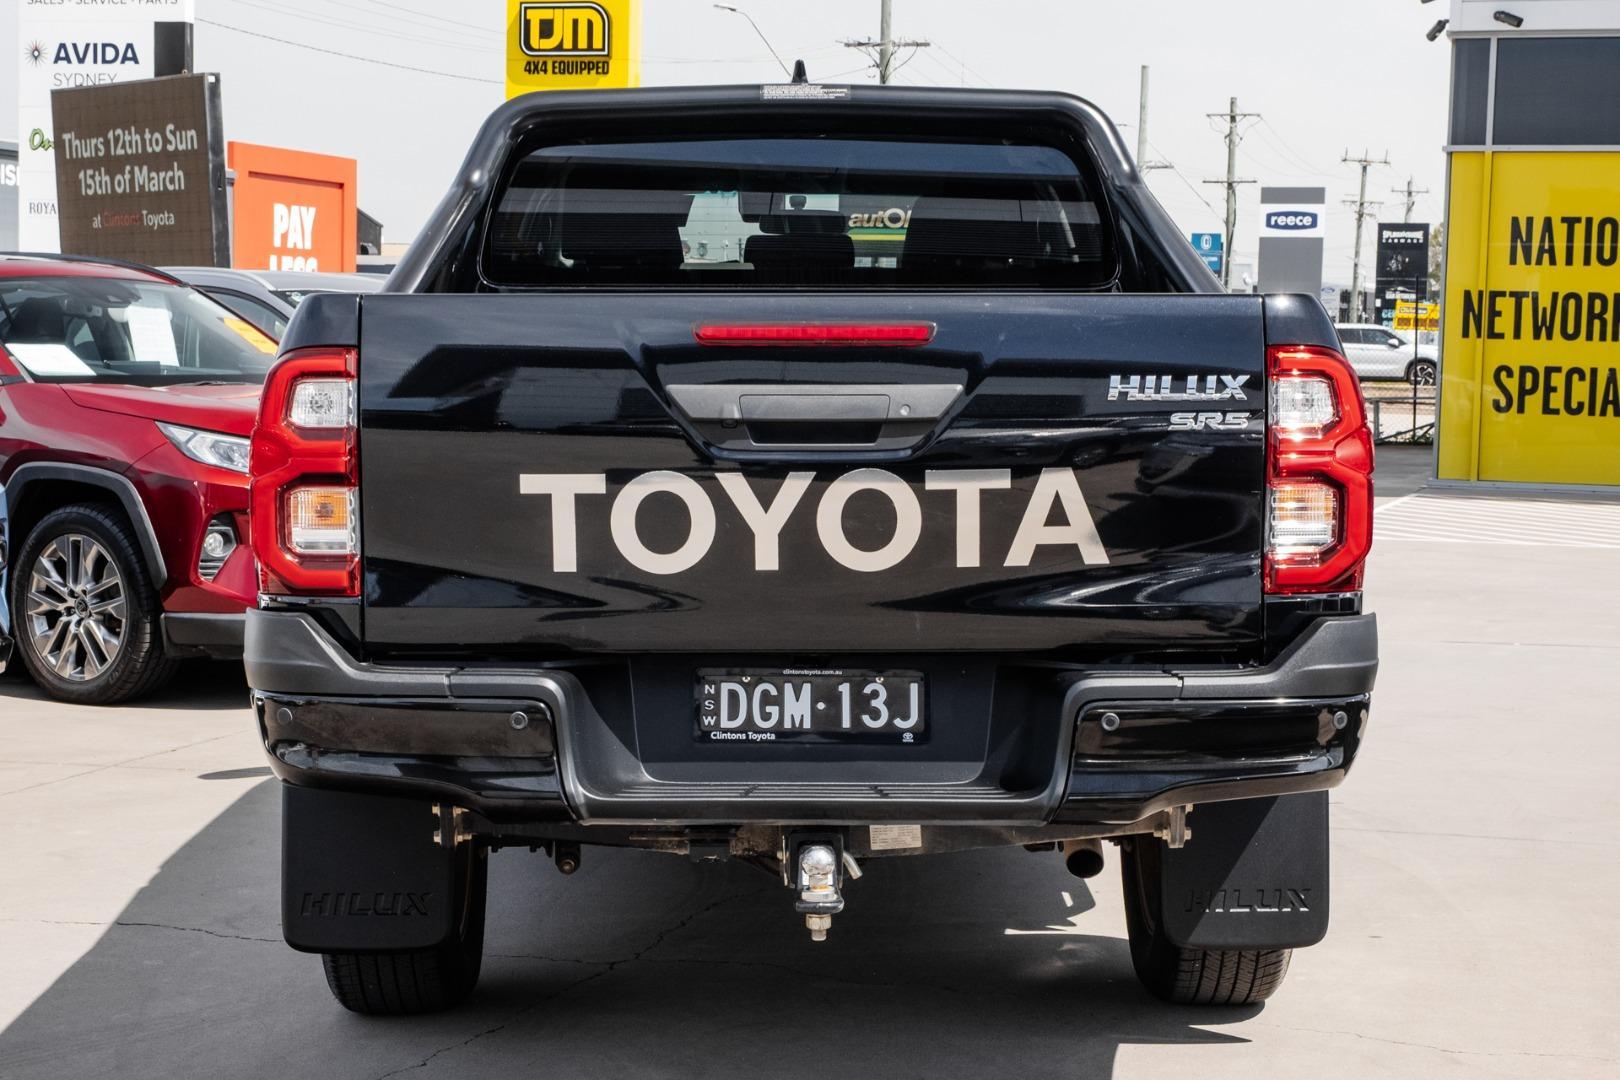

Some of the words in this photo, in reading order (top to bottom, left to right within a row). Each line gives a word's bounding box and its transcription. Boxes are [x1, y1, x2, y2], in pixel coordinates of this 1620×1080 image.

[526, 8, 603, 50] TJM
[53, 42, 140, 65] AVIDA
[53, 72, 117, 87] SYDNEY
[524, 61, 548, 75] 4X4
[552, 61, 610, 75] EQUIPPED
[62, 131, 105, 159] Thurs
[108, 126, 141, 156] 12th
[144, 131, 162, 153] to
[166, 123, 198, 151] Sun
[79, 168, 111, 196] 15th
[114, 166, 131, 194] of
[134, 161, 185, 193] March
[92, 212, 102, 228] at
[142, 210, 175, 230] Toyota
[273, 203, 317, 250] PAY
[1270, 215, 1312, 226] reece
[1509, 216, 1620, 267] NATIO
[1107, 374, 1250, 401] HILUX
[1492, 364, 1620, 417] SPECIA
[1167, 412, 1250, 431] SR5
[520, 467, 1110, 574] TOYOTA
[710, 731, 746, 740] Clintons
[748, 732, 776, 741] Toyota
[301, 892, 432, 916] HILUX
[1184, 889, 1312, 912] HILUX
